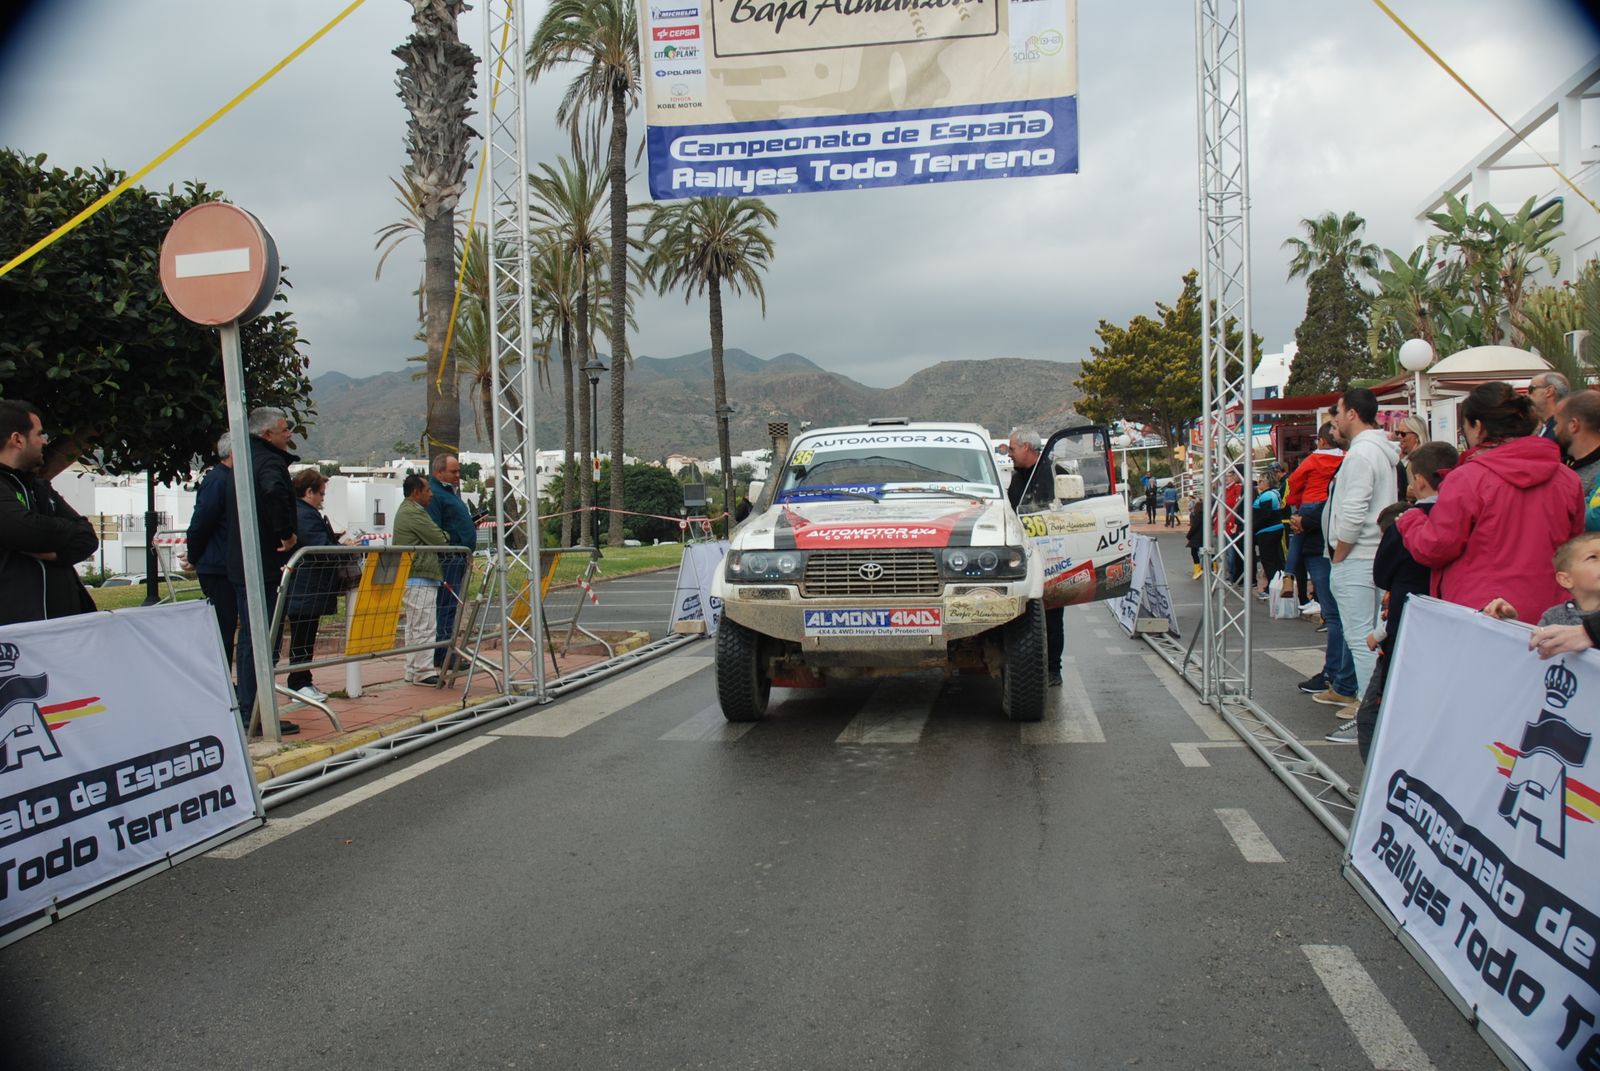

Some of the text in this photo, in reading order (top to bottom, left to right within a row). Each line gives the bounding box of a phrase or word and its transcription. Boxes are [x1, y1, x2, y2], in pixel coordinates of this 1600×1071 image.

[661, 8, 697, 17] MICHELIN
[730, 0, 806, 34] Baja
[669, 28, 696, 38] CEPSA
[678, 114, 1047, 158] Campeonato de España
[672, 147, 1056, 193] Rallyes Todo Terreno
[792, 451, 814, 465] 36
[811, 436, 927, 448] AUTOMOTOR
[1022, 516, 1048, 537] 36
[70, 781, 108, 812] de
[115, 742, 223, 797] España
[1388, 776, 1597, 970] Campeonato de
[1371, 820, 1451, 927] Rallyes
[1454, 901, 1546, 1017] Todo
